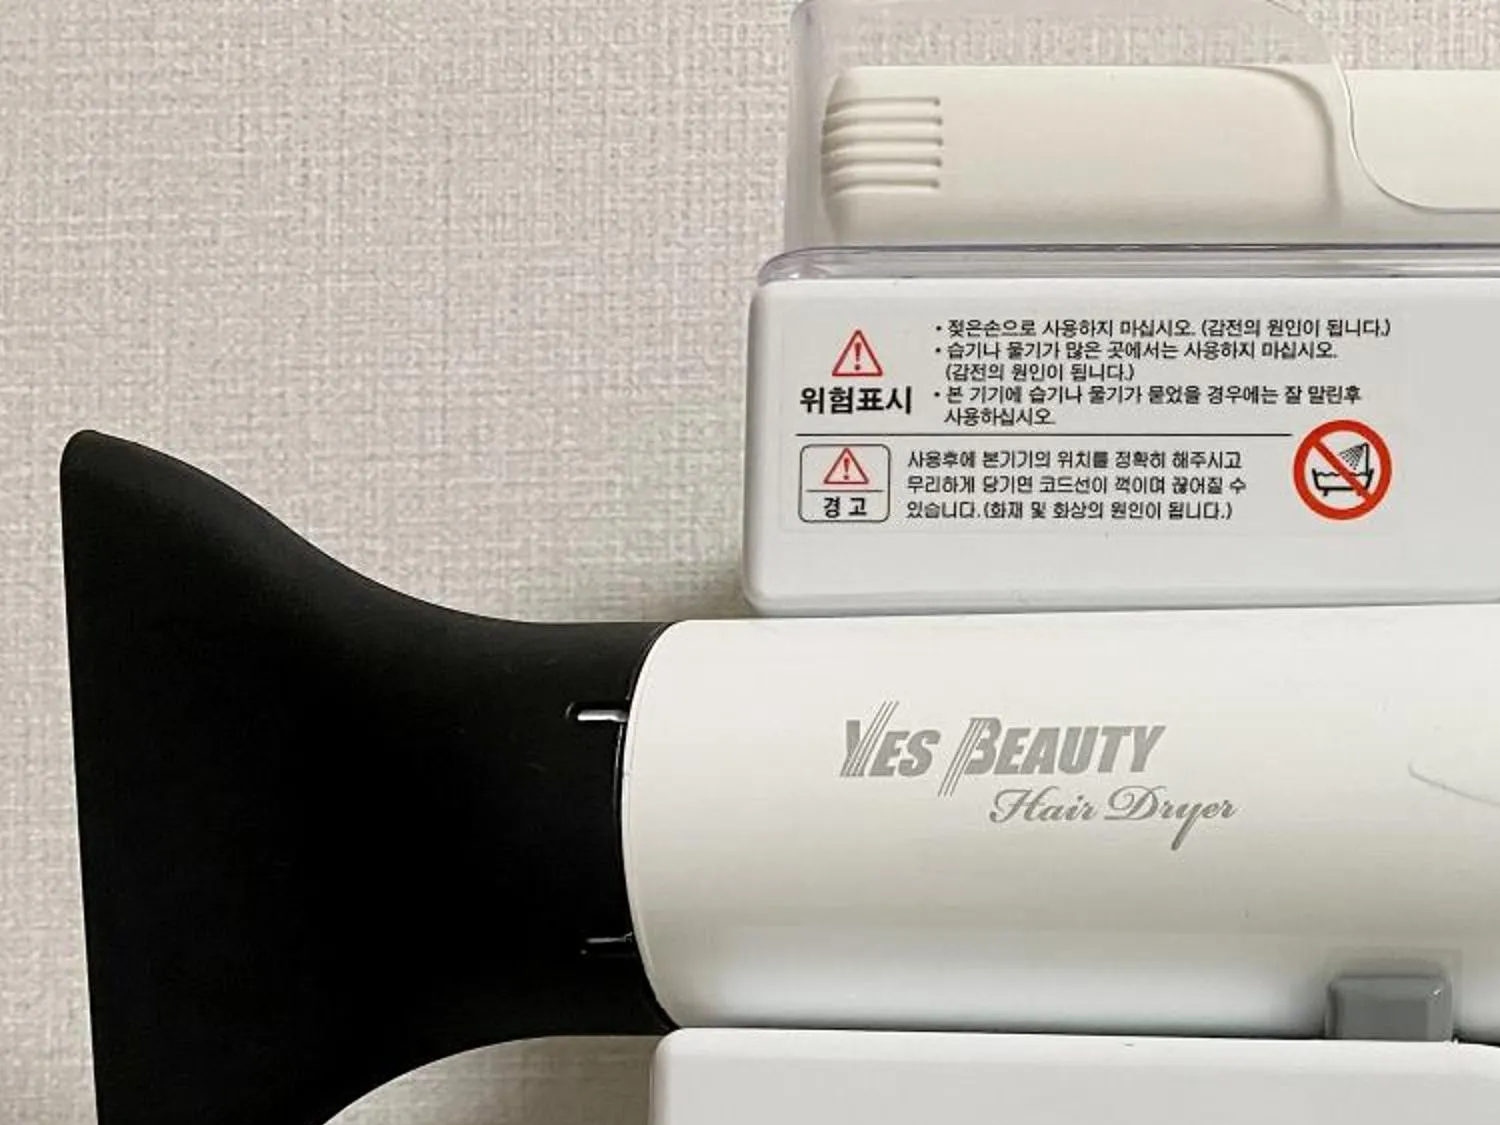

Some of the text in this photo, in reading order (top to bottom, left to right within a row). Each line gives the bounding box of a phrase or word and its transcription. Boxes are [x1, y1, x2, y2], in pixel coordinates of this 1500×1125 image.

[948, 319, 1391, 337] 젖은손으로 사용하지 마십시오. (감전의 원인이 됩니다.)
[948, 341, 1337, 359] 습기나 물기가 많은 곳에서는 사용하지 마십시오.
[946, 364, 1134, 382] (감전의 원인이 됩니다.)
[800, 387, 912, 415] 위험표시
[946, 386, 1360, 404] 본 기기에 습기나 물기가 묻었을 경우에는 잘 말린후
[908, 451, 1241, 468] 사용후에 본기기의 위치를 정확히 해주시고
[908, 476, 975, 493] 무리하게
[983, 476, 1032, 493] 당기면
[1040, 476, 1107, 493] 코드선이
[1172, 476, 1222, 493] 끊어질
[1229, 477, 1246, 493] 수
[1031, 501, 1046, 519] 및
[1053, 501, 1103, 519] 화상의
[1111, 501, 1161, 519] 원인이
[1169, 501, 1232, 520] 됩니다.)
[840, 700, 1165, 797] YES BEAUTY
[989, 785, 1238, 851] Hair Dryer
